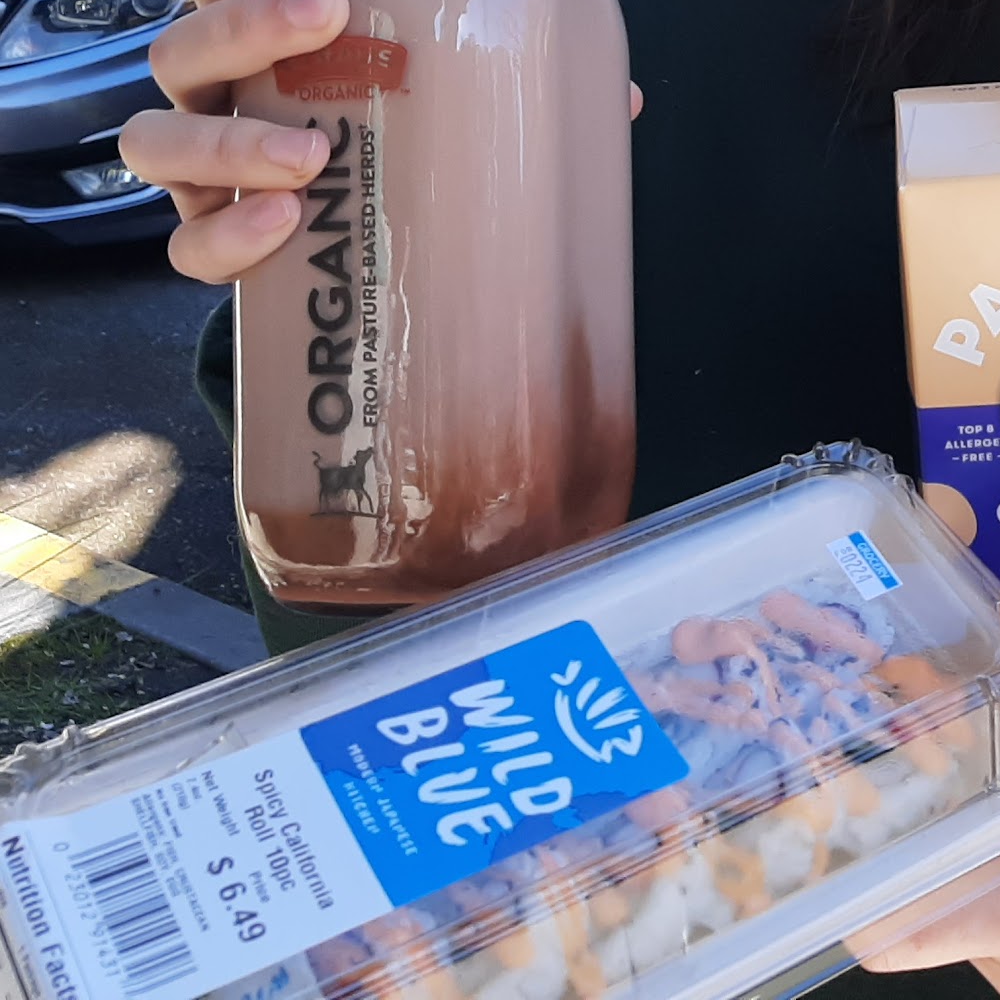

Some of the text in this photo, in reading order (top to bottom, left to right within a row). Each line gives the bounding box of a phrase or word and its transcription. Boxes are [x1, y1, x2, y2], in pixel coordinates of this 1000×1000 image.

[361, 203, 379, 362] PASTURE-BASED
[362, 368, 378, 429] FROM
[957, 424, 995, 435] TOP 8
[961, 452, 994, 463] FREE
[347, 743, 383, 794] MODERN
[448, 677, 574, 817] WILD
[201, 770, 241, 837] Net Weight
[343, 781, 382, 835] KITCHEN
[376, 797, 419, 857] JAPANESE
[244, 804, 296, 892] Roll 10pc
[254, 768, 335, 911] Spicy California
[2, 834, 52, 938] Nutrition
[218, 881, 268, 943] 6.49
[249, 869, 271, 904] Price
